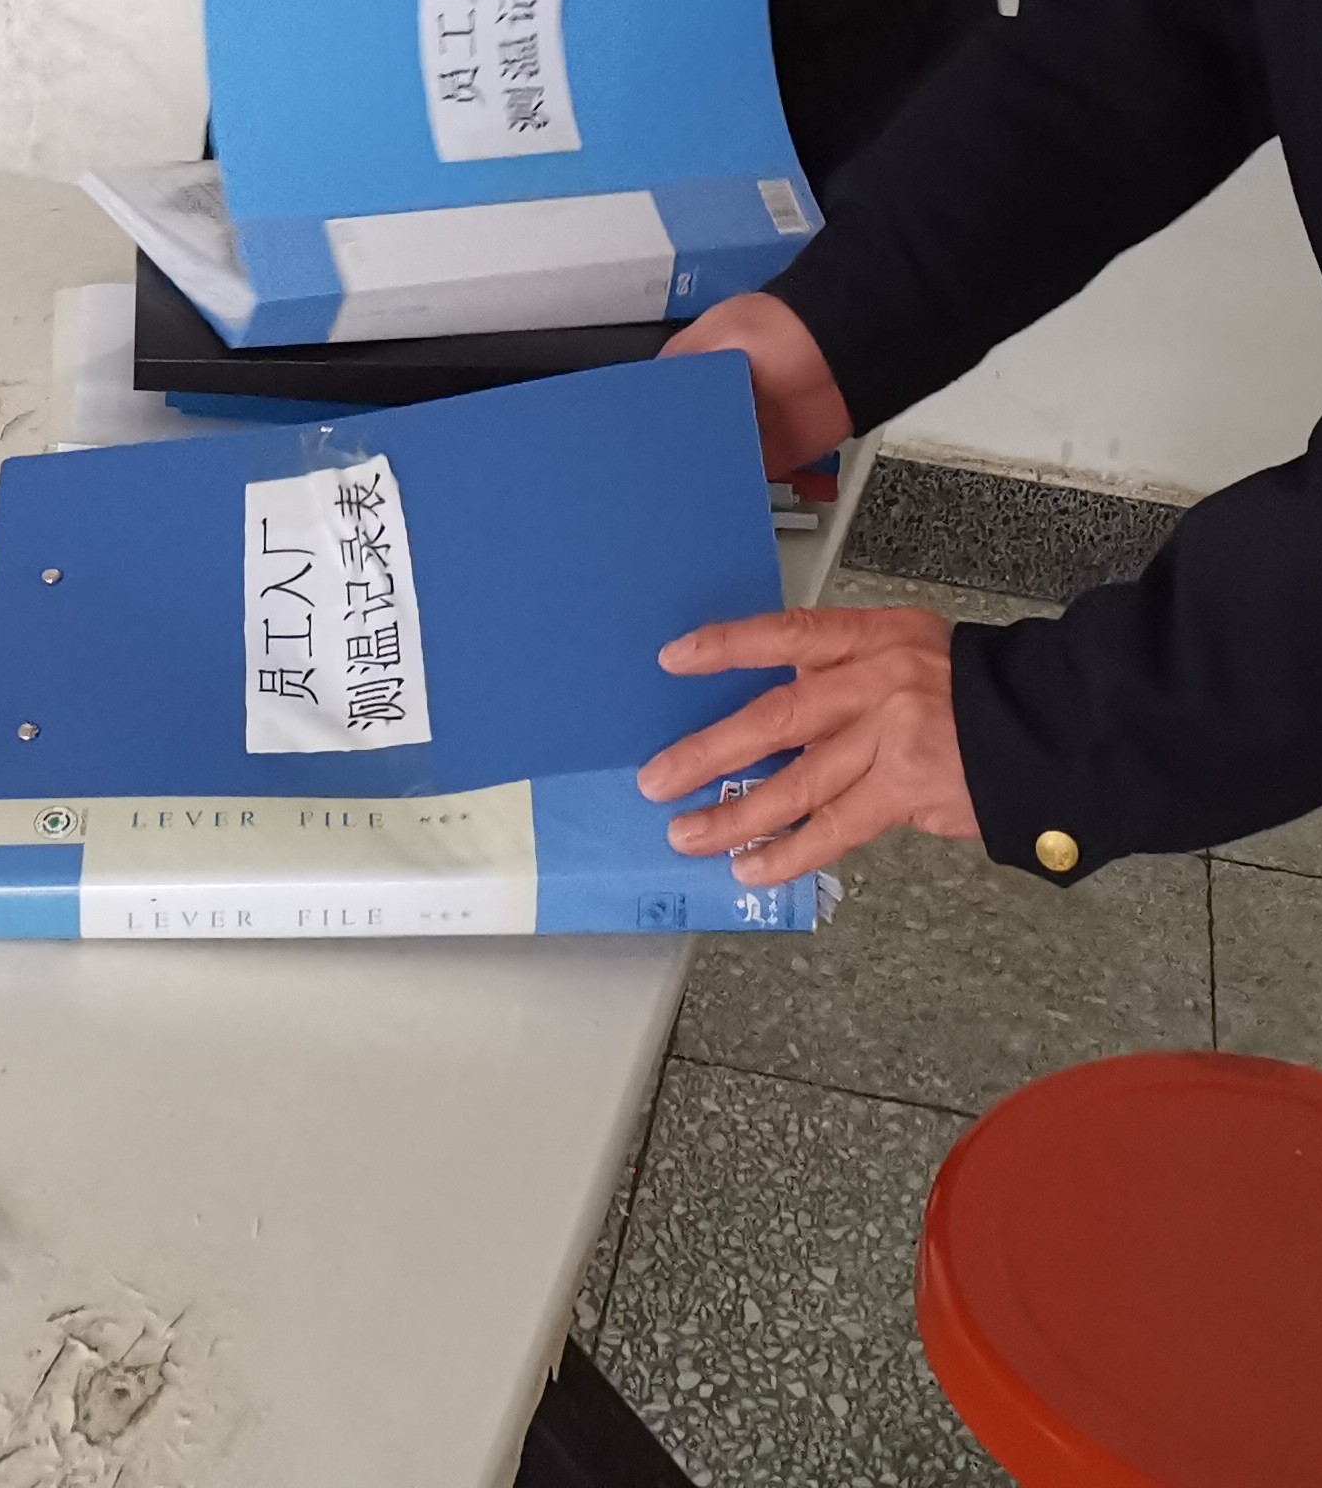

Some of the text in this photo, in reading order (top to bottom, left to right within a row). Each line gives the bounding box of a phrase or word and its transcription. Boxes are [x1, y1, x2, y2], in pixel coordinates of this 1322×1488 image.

[258, 517, 319, 705] 员工入厂
[334, 472, 406, 731] 测温记录表
[131, 810, 384, 829] LEVER FILE
[127, 907, 383, 930] LEVER FILE
